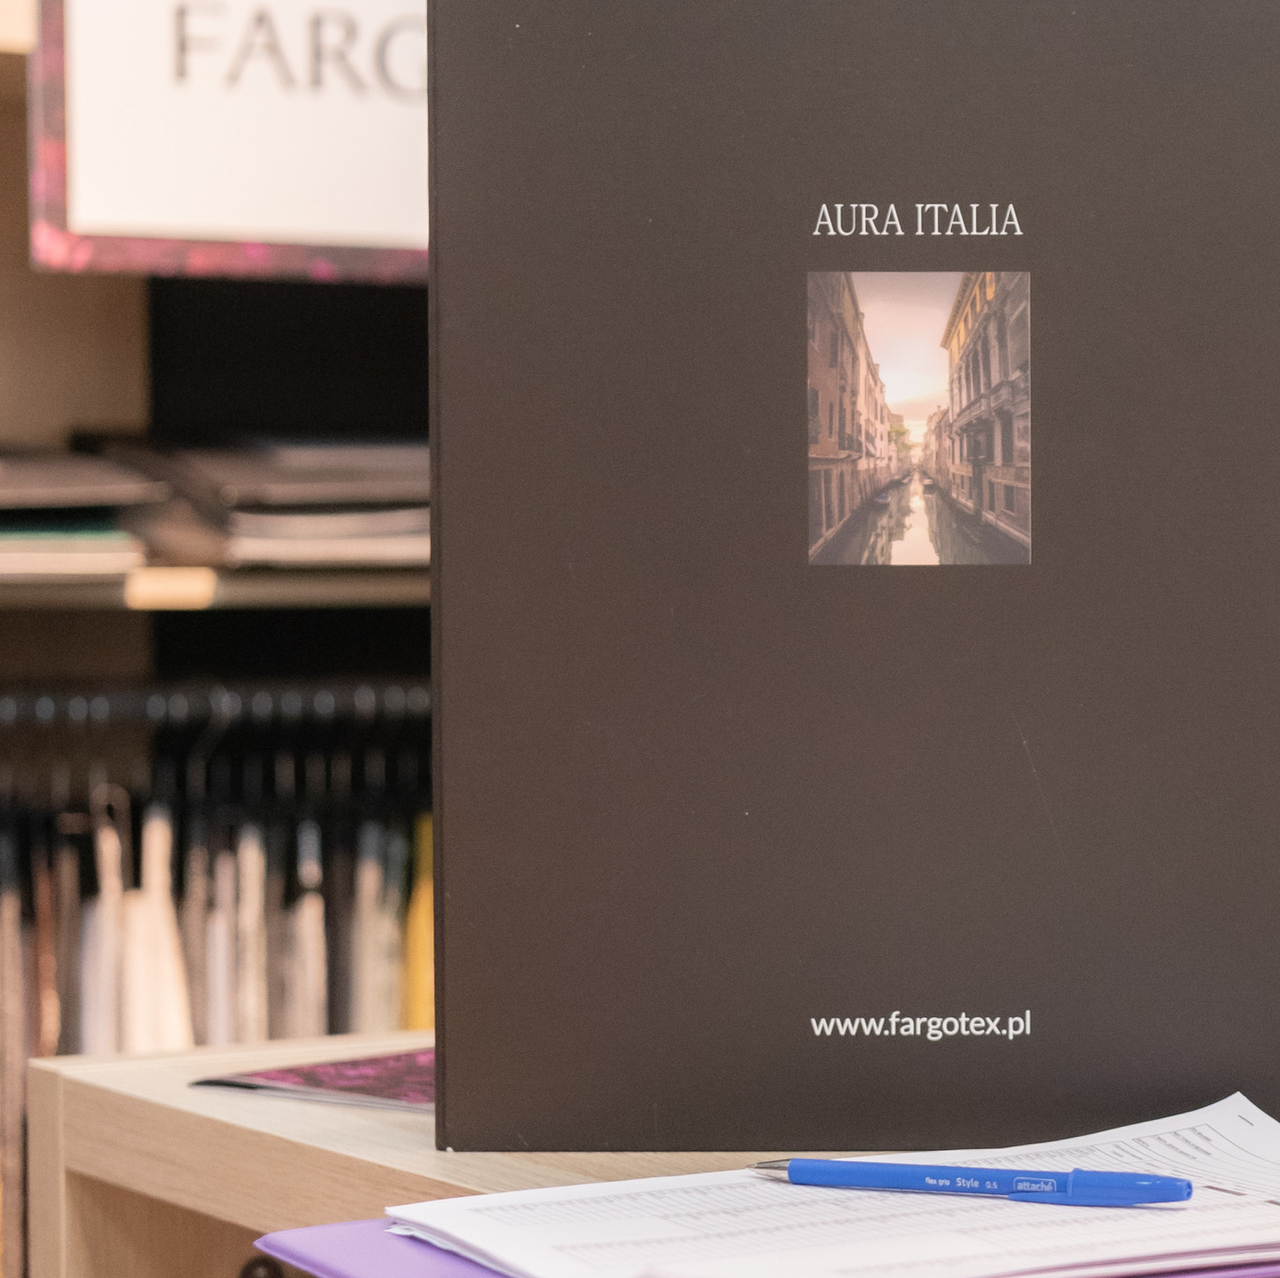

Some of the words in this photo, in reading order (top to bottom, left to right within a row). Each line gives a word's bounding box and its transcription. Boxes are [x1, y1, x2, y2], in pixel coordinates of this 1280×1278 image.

[812, 203, 904, 236] AURA
[914, 203, 1024, 236] ITALIA
[810, 1009, 1032, 1042] www.fargotex.pl
[956, 1177, 979, 1189] Style
